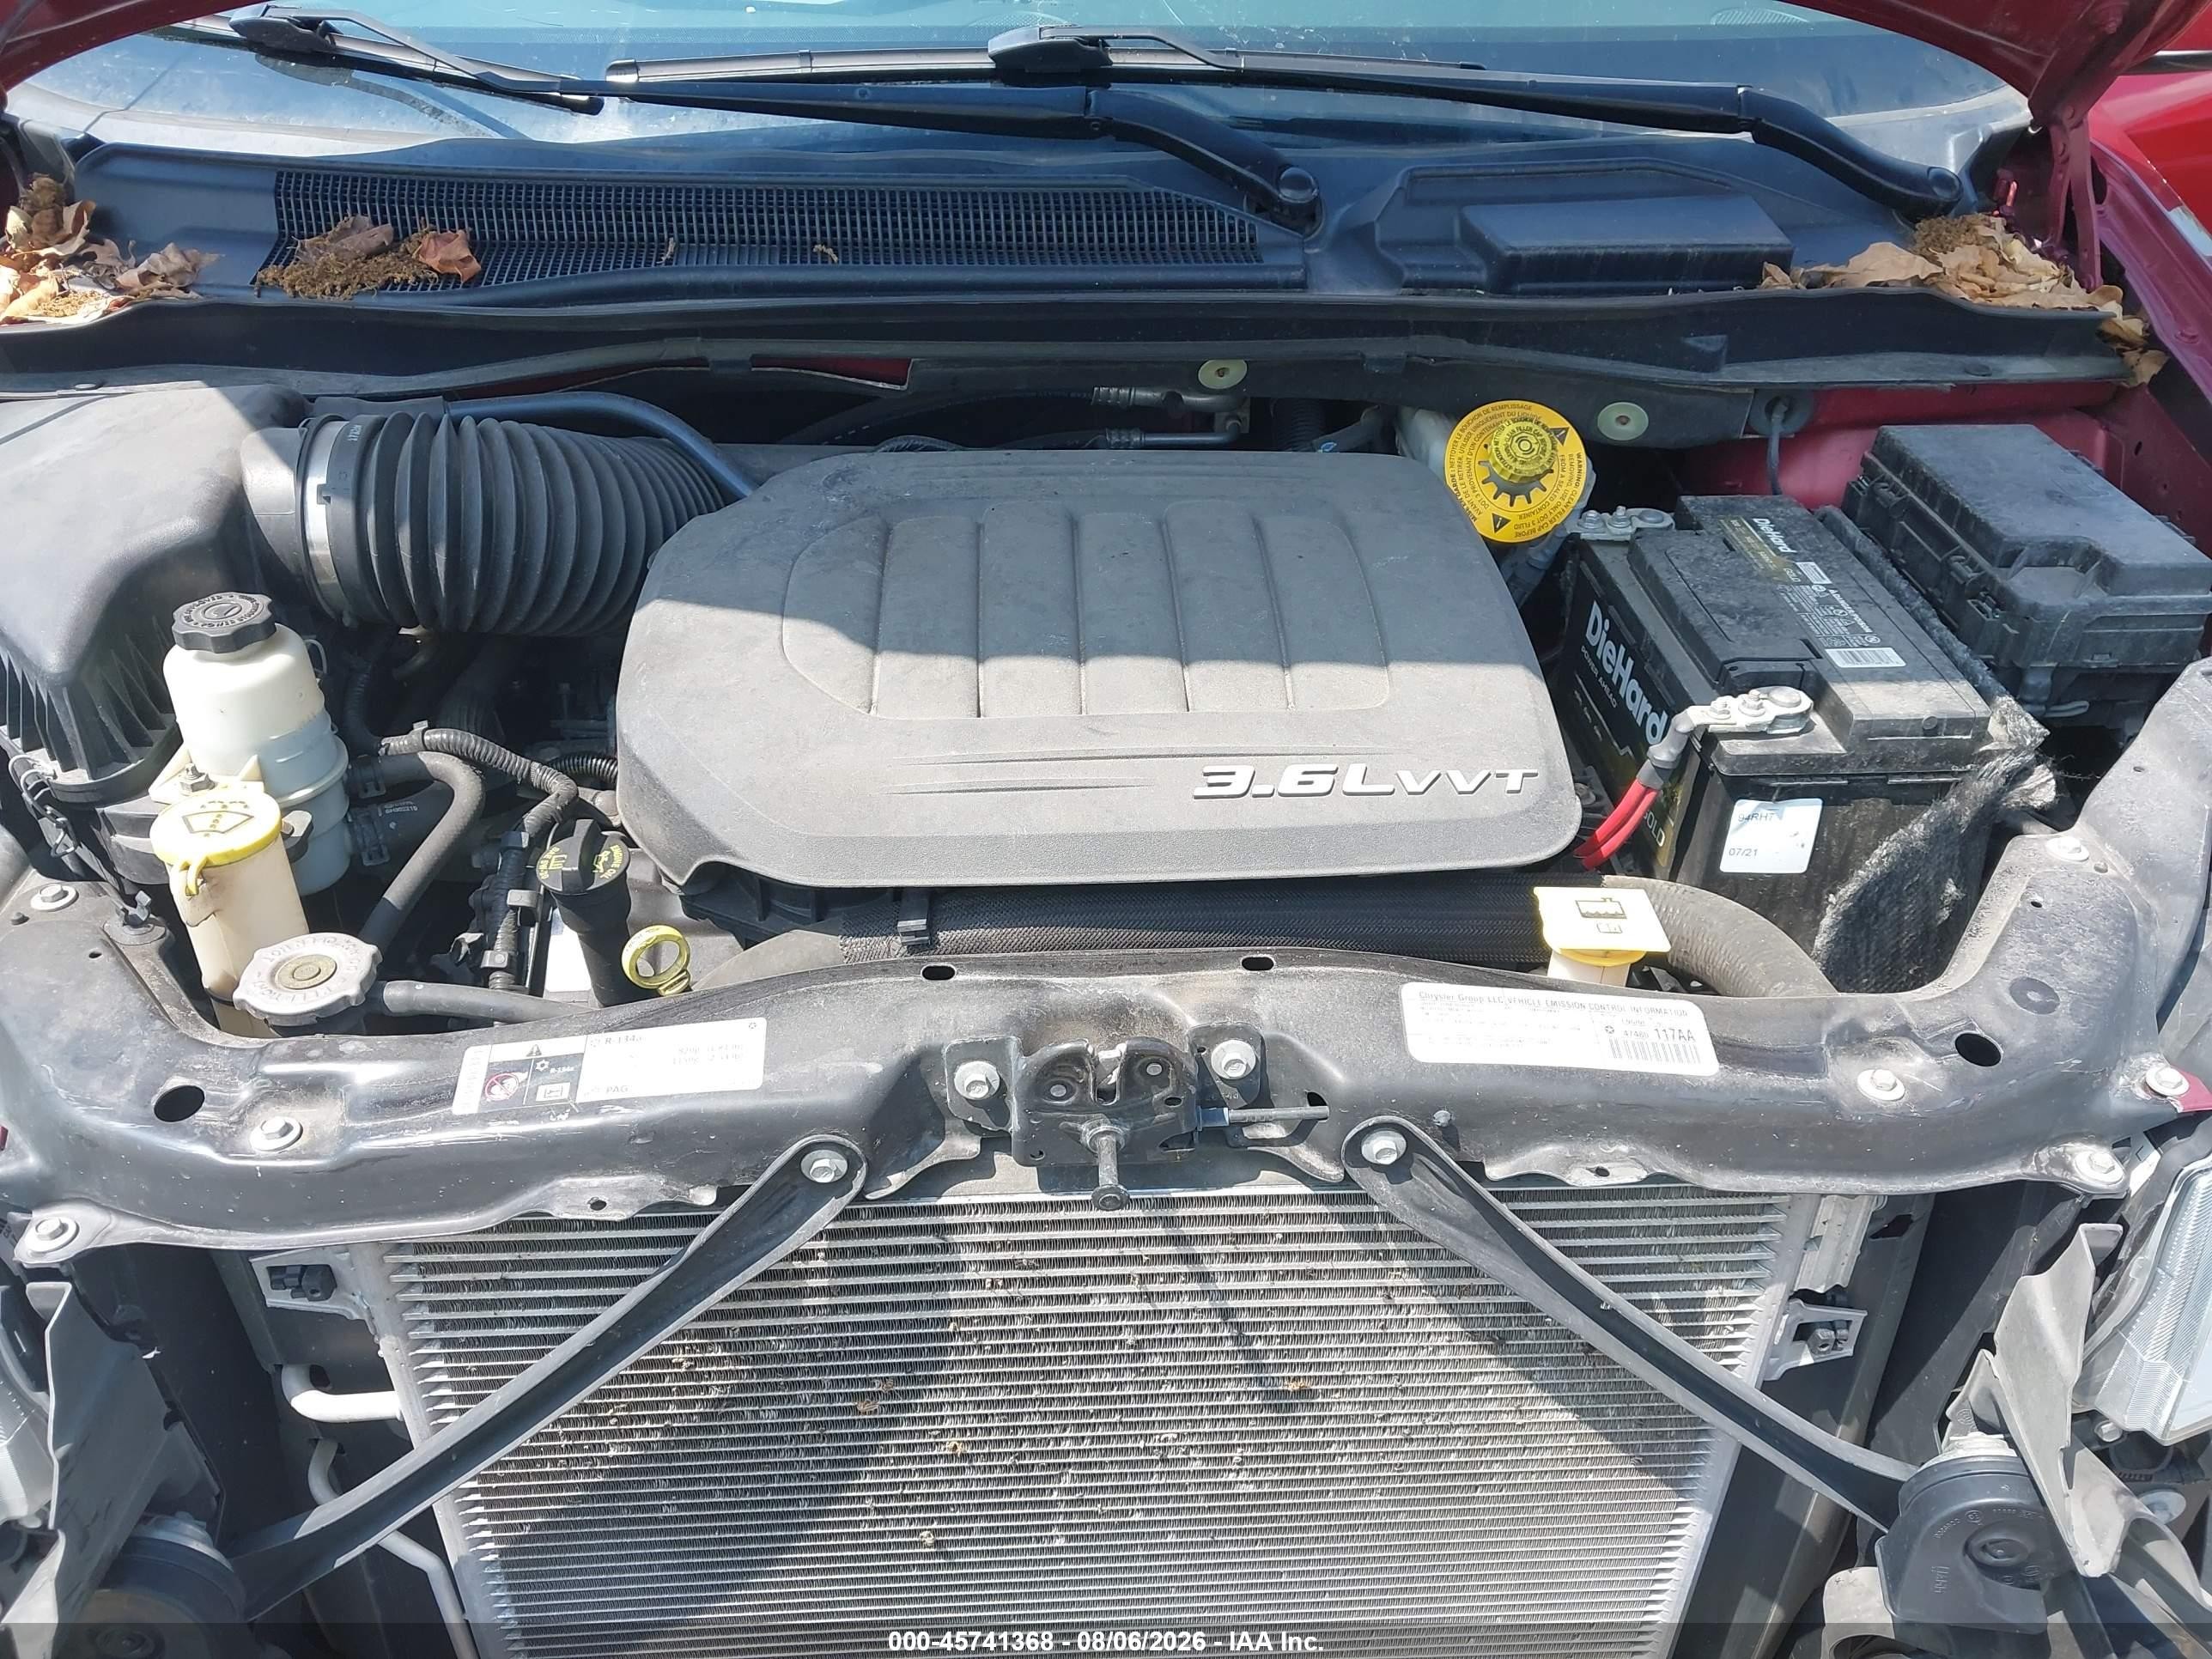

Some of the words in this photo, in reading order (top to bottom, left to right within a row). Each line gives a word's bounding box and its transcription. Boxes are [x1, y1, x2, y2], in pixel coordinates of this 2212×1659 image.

[1459, 431, 1473, 454] UTILISER
[1449, 441, 1459, 469] NETTOYER
[1465, 458, 1479, 493] PROVENANT
[1462, 489, 1470, 498] DE
[1549, 478, 1565, 502] SEALED
[1560, 489, 1570, 501] USE
[1468, 498, 1482, 516] AVANT
[1479, 498, 1490, 510] DOT
[1547, 501, 1561, 516] ONLY
[1564, 489, 1578, 510] CLEAN
[1536, 515, 1548, 524] DOT
[1548, 507, 1565, 526] FILLER
[1514, 527, 1537, 538] BEFORE
[1536, 520, 1549, 532] CAP
[1752, 518, 1798, 554] DieHard
[1581, 645, 1599, 678] POWER
[1597, 676, 1618, 708] AHEAD
[1585, 600, 1668, 745] DieHard
[610, 844, 623, 868] ENGINE
[1729, 848, 1759, 857] 07/21
[599, 868, 617, 880] OIL
[1457, 994, 1485, 1004] Group
[1507, 997, 1542, 1006] VEHICLE
[1545, 1000, 1586, 1009] EMISSION
[1588, 1002, 1626, 1012] CONTROL
[1630, 1006, 1688, 1017] INFORMATION
[1654, 1028, 1697, 1042] 117AA
[605, 1085, 629, 1094] PAG
